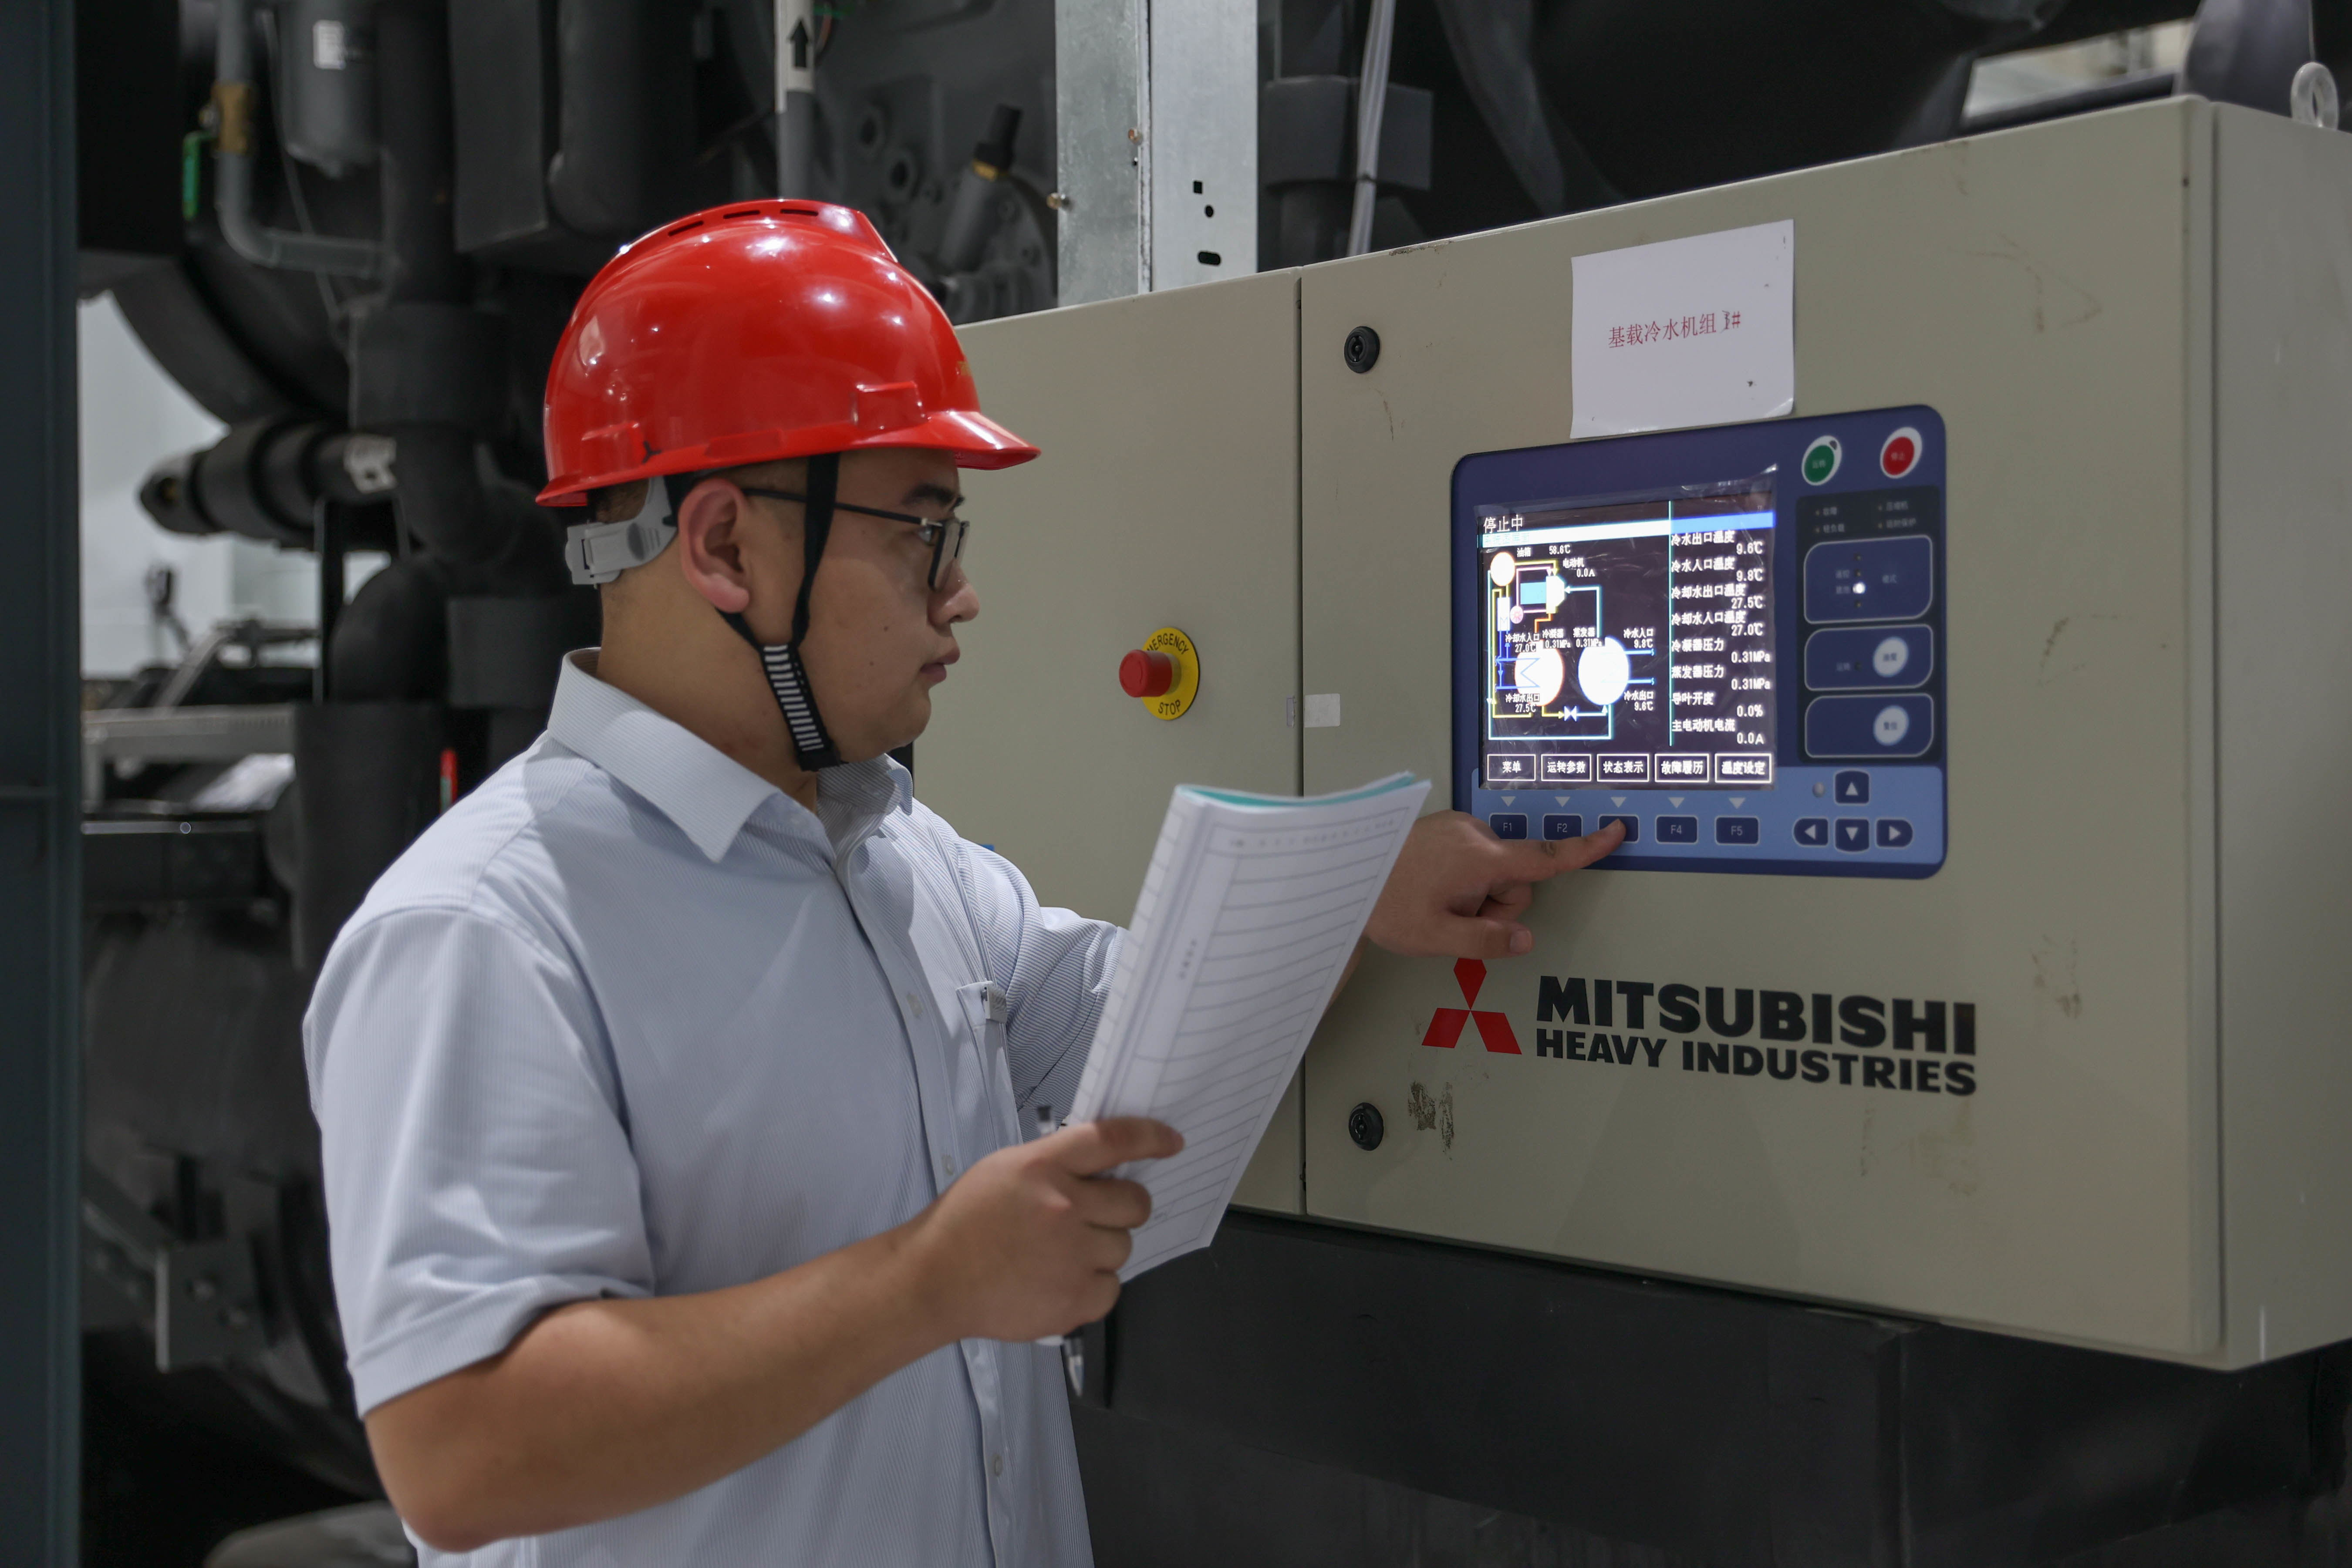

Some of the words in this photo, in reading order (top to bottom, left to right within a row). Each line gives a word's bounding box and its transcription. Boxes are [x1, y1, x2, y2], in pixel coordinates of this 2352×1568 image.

[1608, 312, 1717, 348] 基载冷水机组
[1483, 514, 1523, 533] 停止中
[1736, 541, 1763, 555] 9.6℃
[1576, 569, 1596, 578] 0.0A
[1736, 568, 1763, 582] 9.8℃
[1731, 595, 1763, 609] 27.5℃
[1731, 622, 1763, 636] 27.0℃
[1147, 633, 1189, 654] MERGENCY
[1731, 650, 1771, 663] 0.31MPa
[1731, 678, 1771, 690] 0.31MPa
[1158, 699, 1181, 715] STOP
[1737, 704, 1764, 717] 0.0%
[1737, 732, 1764, 745] 0.0A
[1502, 760, 1522, 773] 菜单
[1547, 760, 1586, 774] 运转参数
[1603, 760, 1644, 774] 状态表示
[1503, 822, 1512, 831] F1
[1557, 823, 1568, 833] F2
[1670, 824, 1682, 835] F4
[1731, 826, 1743, 836] F5
[1537, 975, 1977, 1055] MITSUBISHI
[1536, 1028, 1667, 1068] HEAVY
[1682, 1041, 1977, 1097] INDUSTRIES
